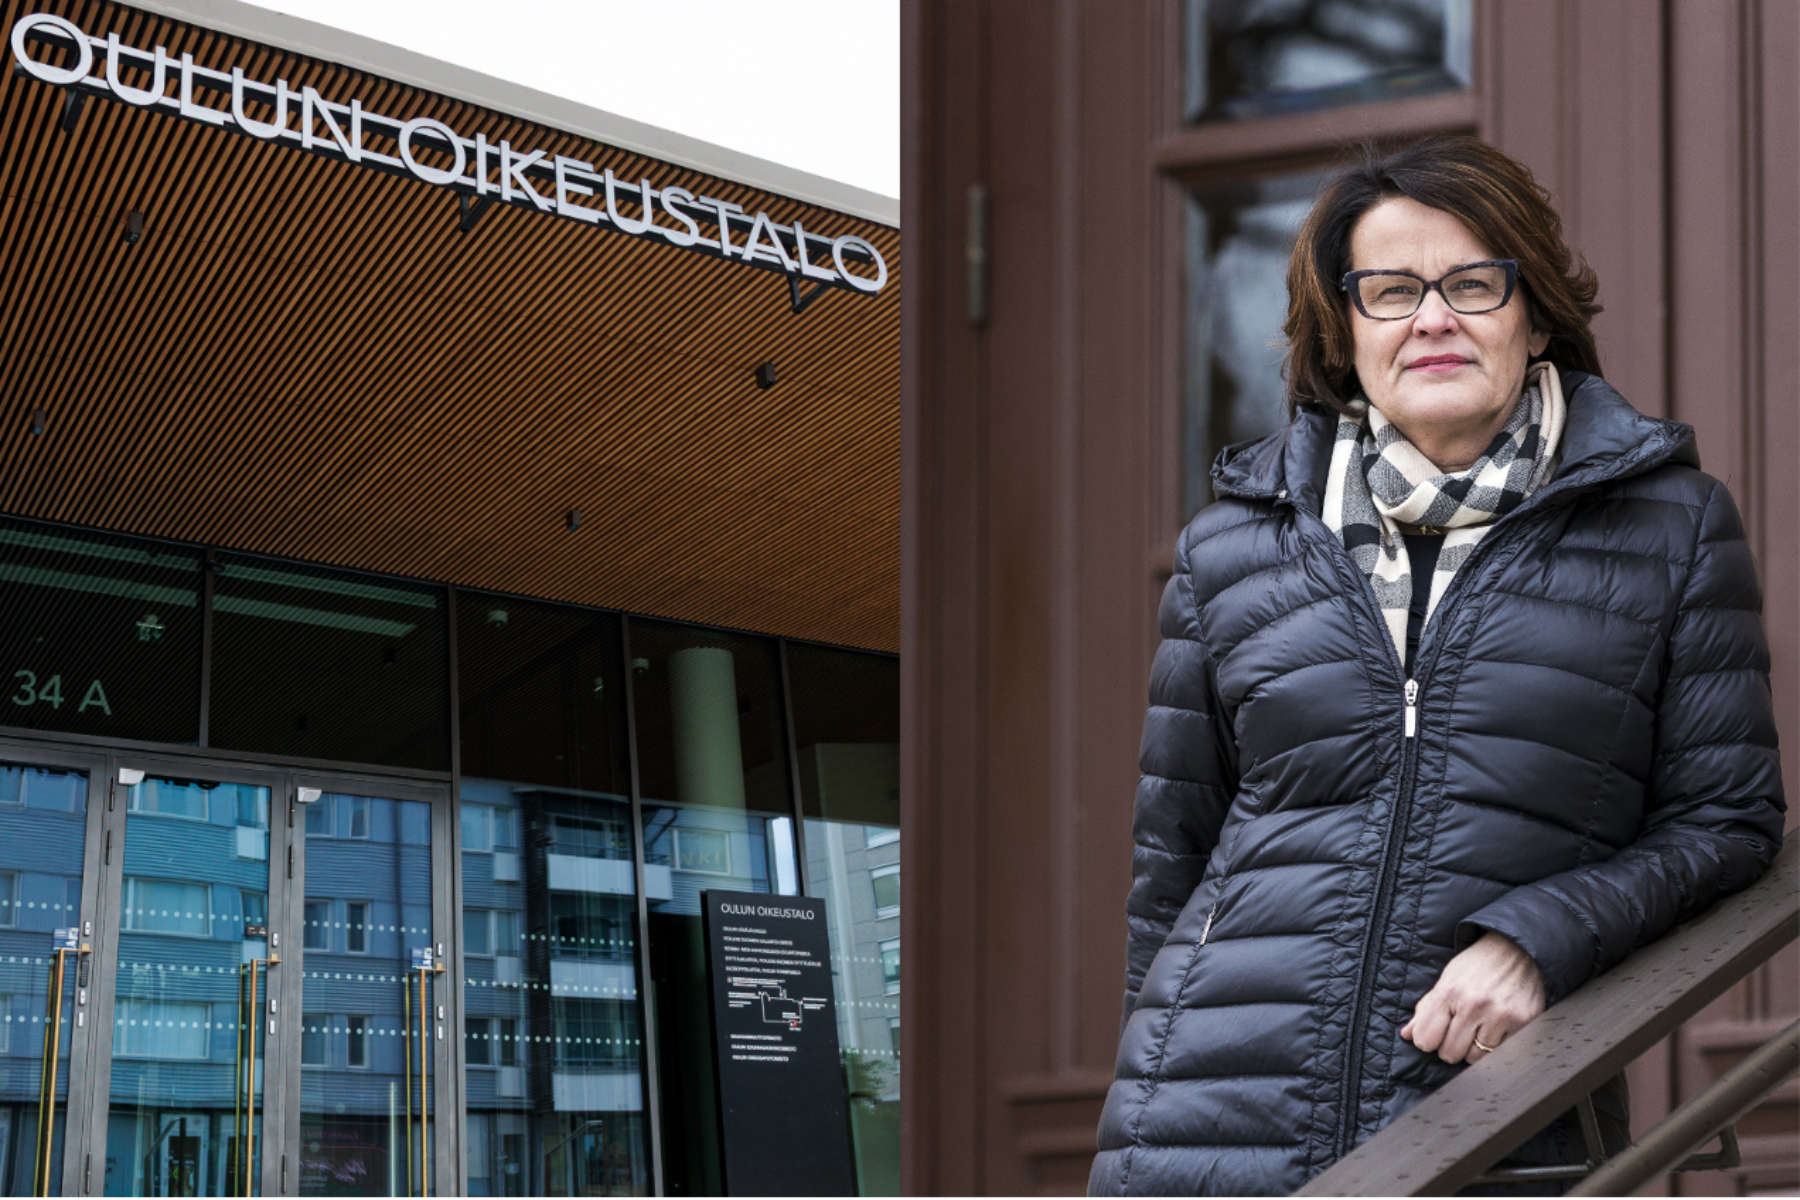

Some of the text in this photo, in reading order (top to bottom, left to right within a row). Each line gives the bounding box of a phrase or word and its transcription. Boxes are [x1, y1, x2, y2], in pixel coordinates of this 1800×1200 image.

[10, 12, 888, 293] OULUN OIKEUSTALO
[12, 669, 112, 715] 34 A
[721, 903, 815, 920] OULUN OIKEUSTALO
